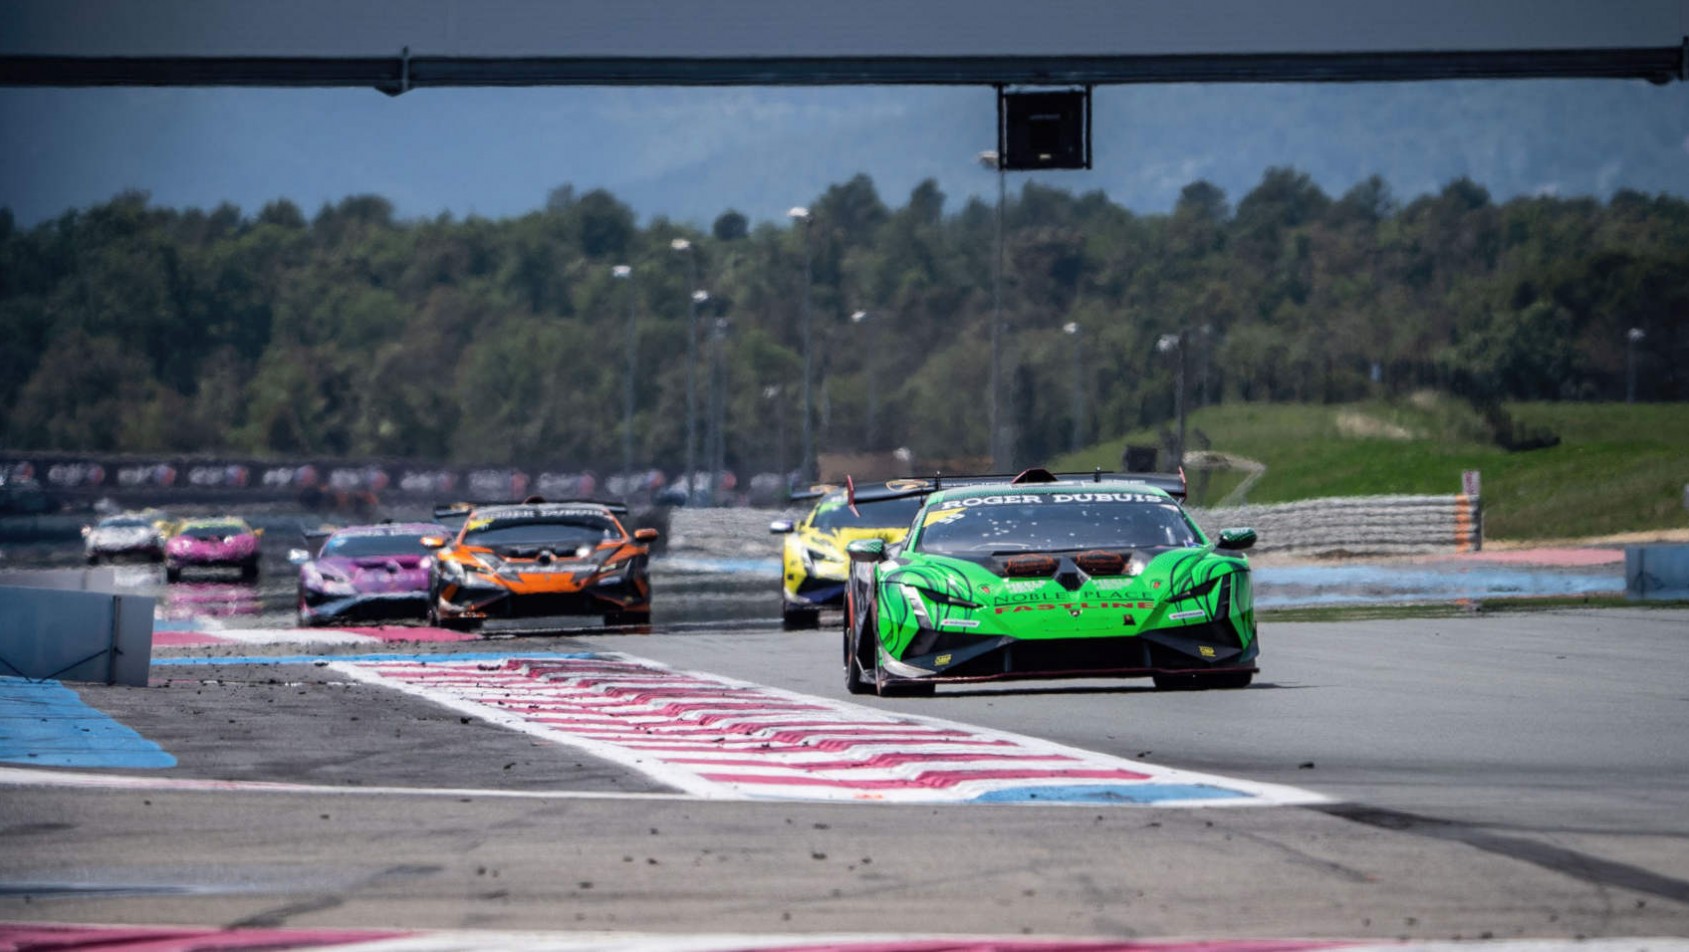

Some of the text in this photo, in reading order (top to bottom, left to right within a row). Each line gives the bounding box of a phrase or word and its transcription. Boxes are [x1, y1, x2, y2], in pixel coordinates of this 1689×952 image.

[941, 493, 1163, 509] ROGER DUBUIS
[994, 590, 1153, 604] NOBLE PLACE
[995, 602, 1154, 614] FASTLINE
